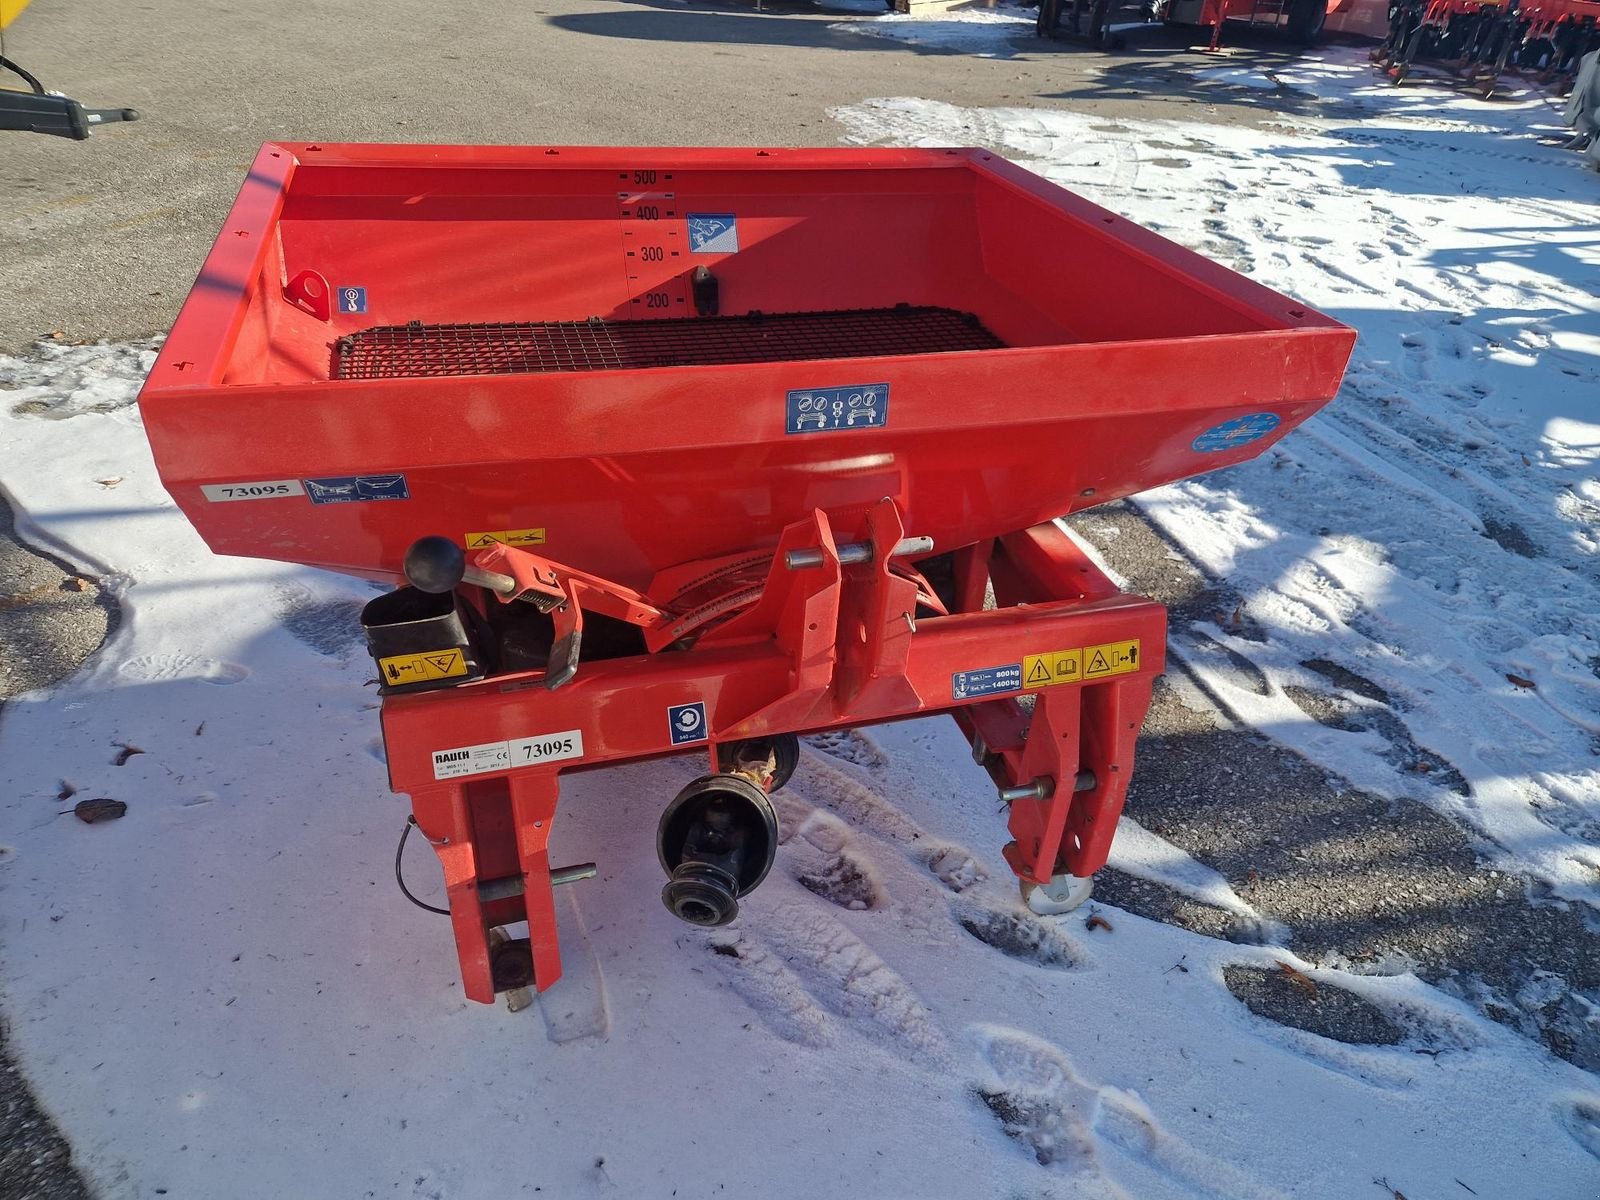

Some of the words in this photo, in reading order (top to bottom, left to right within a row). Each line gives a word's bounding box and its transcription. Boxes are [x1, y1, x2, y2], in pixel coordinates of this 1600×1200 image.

[634, 170, 656, 184] 500
[637, 206, 658, 220] 400
[641, 246, 663, 261] 300
[646, 293, 669, 308] 200
[222, 485, 290, 498] 73095
[996, 670, 1010, 678] 800
[992, 680, 1010, 689] 1400
[523, 739, 573, 759] 73095
[435, 750, 470, 764] RAUCH
